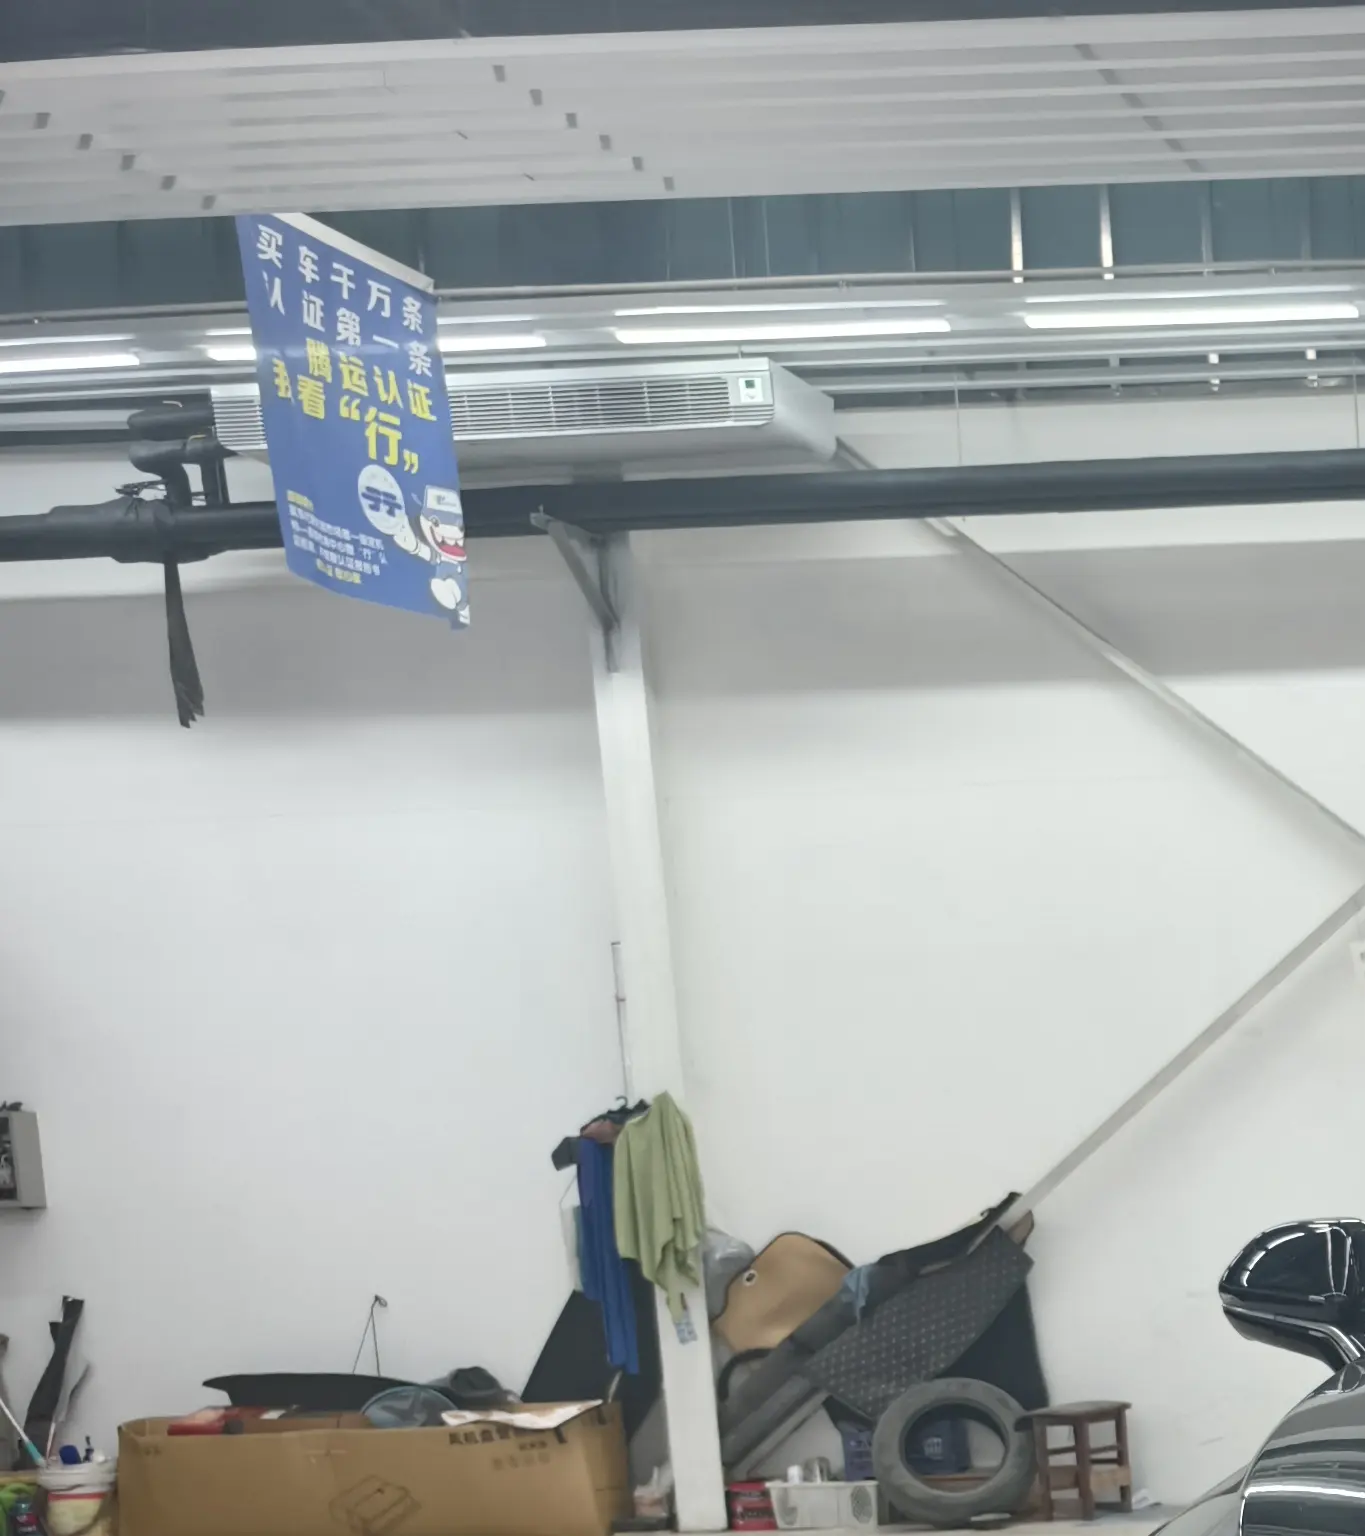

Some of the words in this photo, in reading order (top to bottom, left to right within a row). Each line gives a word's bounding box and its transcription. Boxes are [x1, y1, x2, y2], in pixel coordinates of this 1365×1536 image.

[263, 270, 433, 377] 认证第一条
[306, 337, 437, 421] 腾运认证
